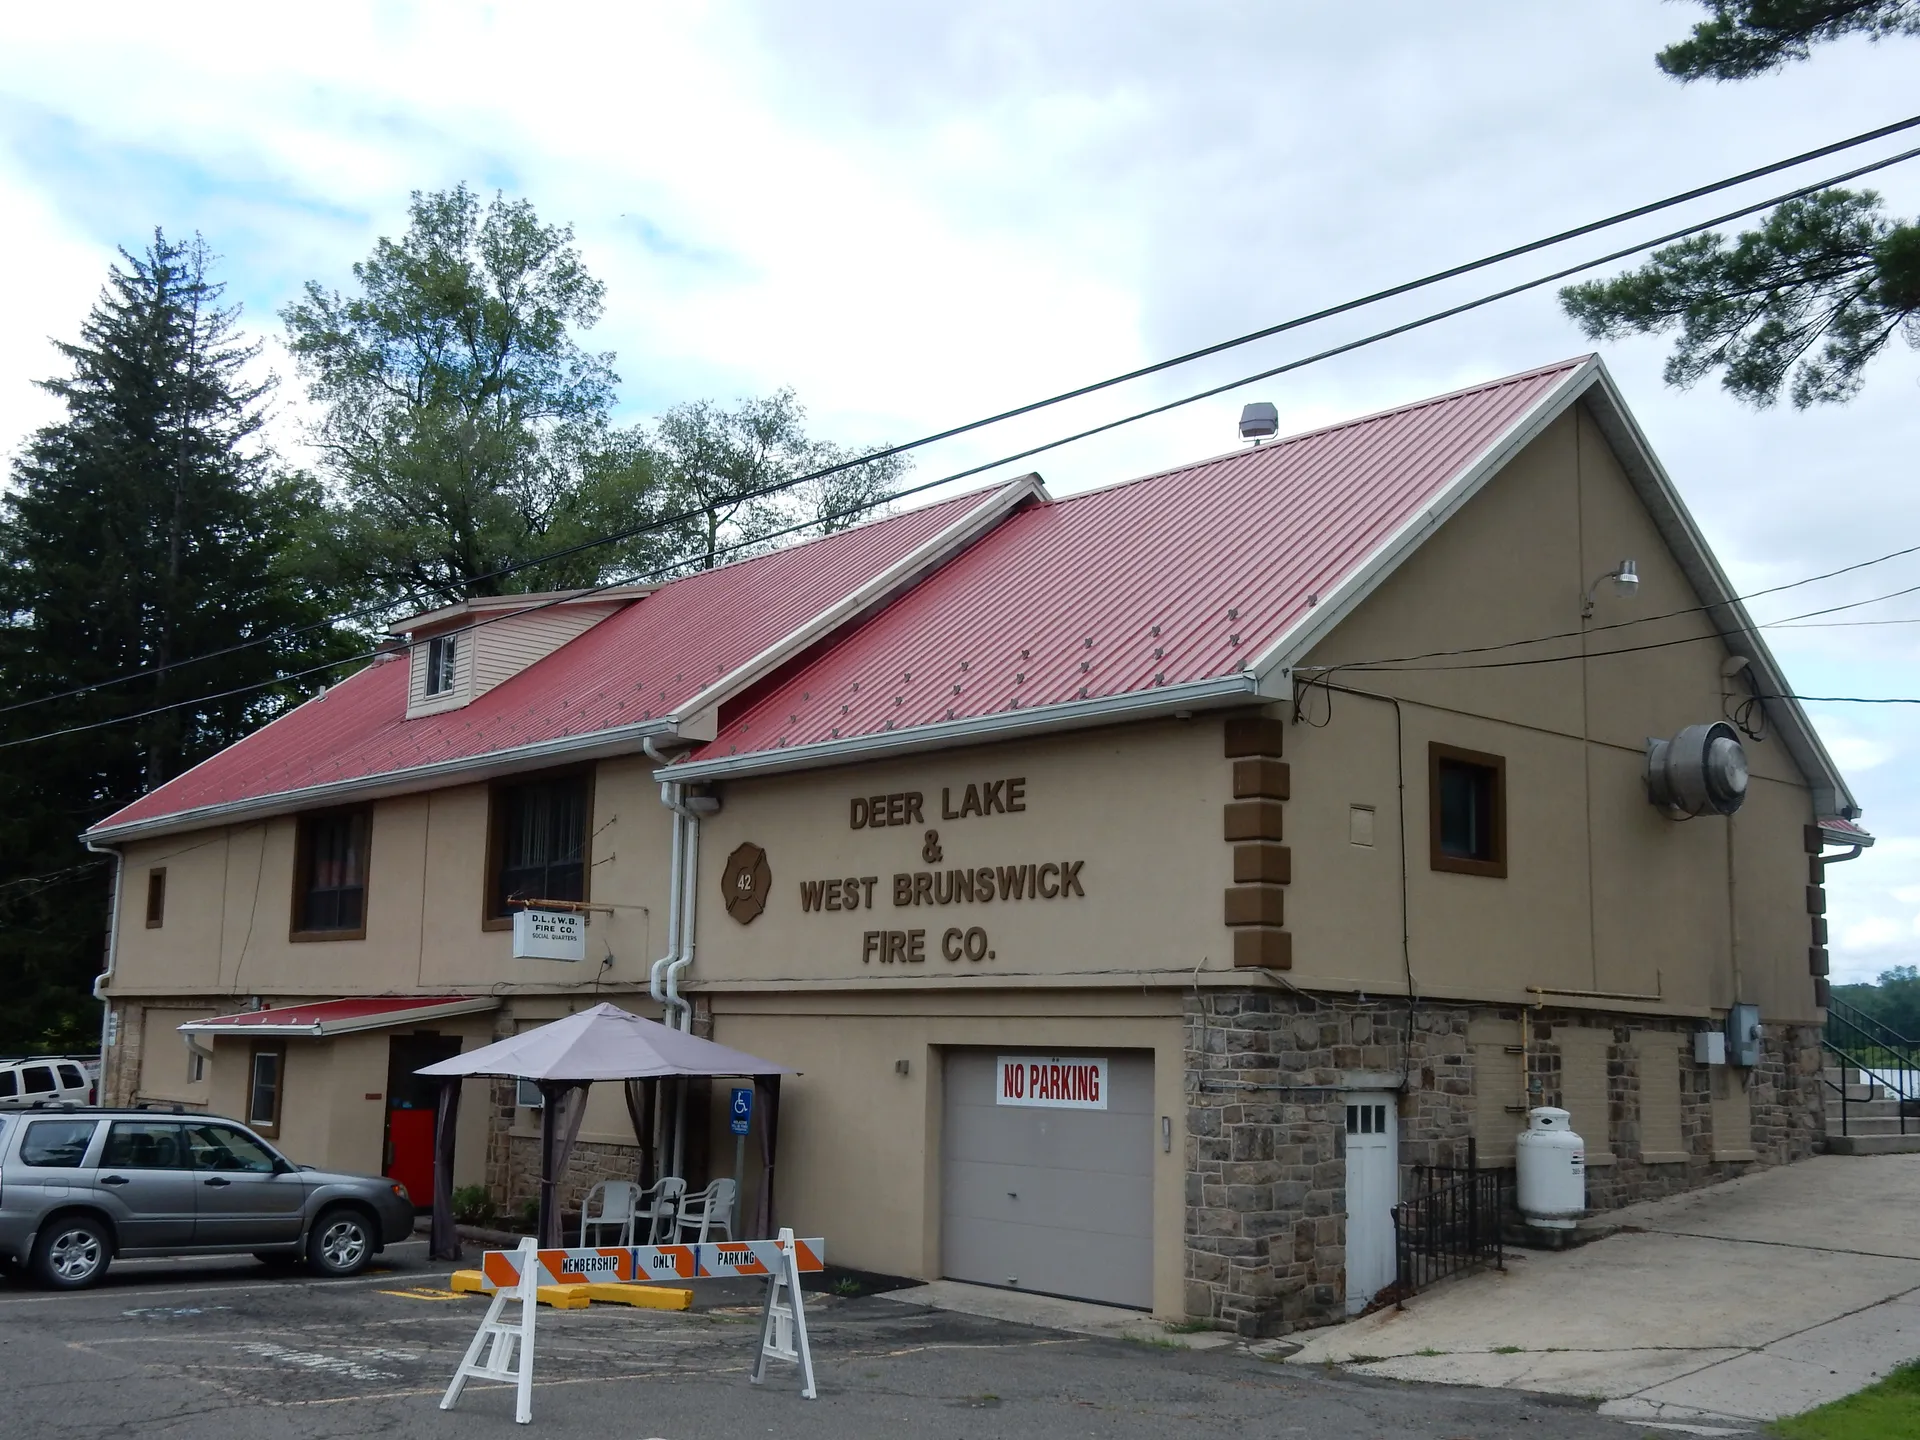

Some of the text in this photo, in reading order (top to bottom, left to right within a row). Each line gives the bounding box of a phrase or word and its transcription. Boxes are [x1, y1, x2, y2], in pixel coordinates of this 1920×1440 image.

[850, 777, 1026, 829] DEER LAKE
[922, 829, 943, 863] &
[737, 874, 752, 890] 42
[800, 860, 1085, 912] WEST BRUNSWICK
[862, 926, 995, 963] FIRE CO.
[1004, 1063, 1099, 1102] NO PARKING
[562, 1250, 754, 1273] MEMBERSHIP ONLY PARKING
